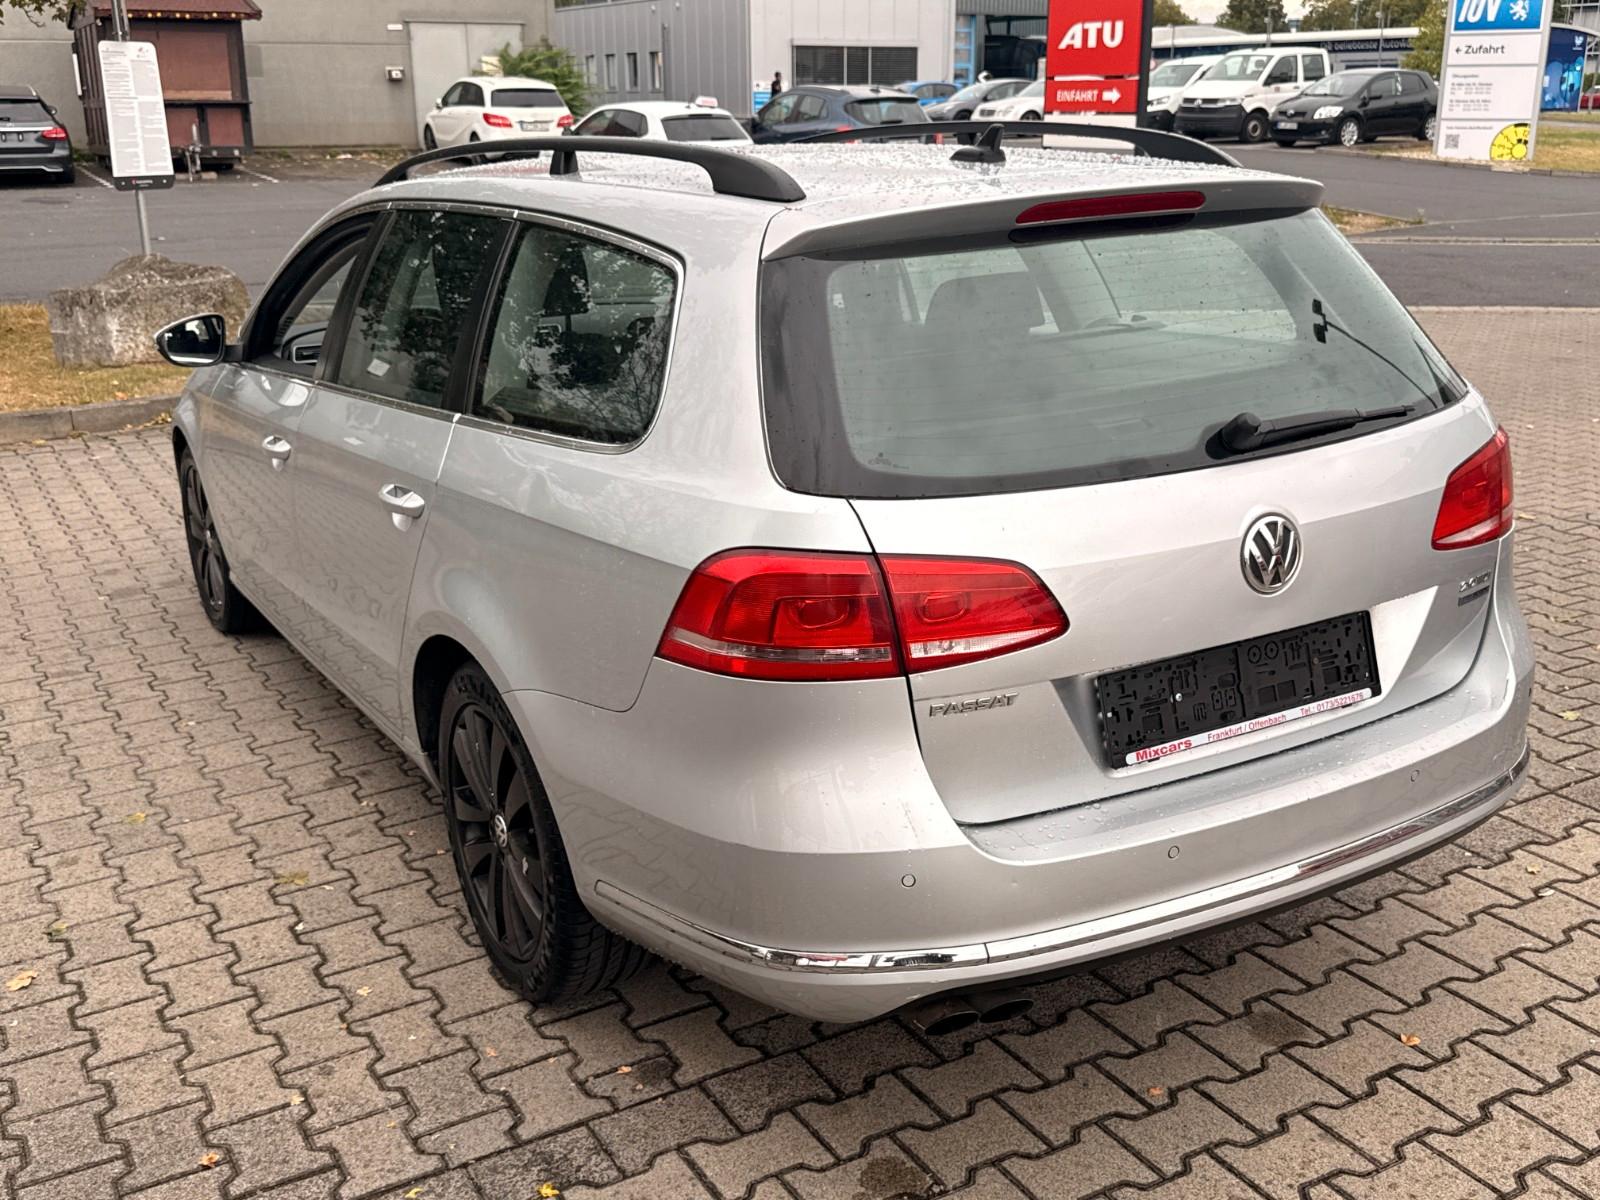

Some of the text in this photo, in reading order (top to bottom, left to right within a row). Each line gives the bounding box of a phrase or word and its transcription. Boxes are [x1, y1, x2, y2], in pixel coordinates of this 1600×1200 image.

[1057, 20, 1124, 49] ATU
[1464, 45, 1505, 54] Zufahrt
[1056, 89, 1098, 102] EINFAHRT
[929, 691, 1019, 717] PASSAT
[1135, 738, 1193, 762] Mixcars
[1207, 724, 1243, 742] Frankfurt
[1248, 713, 1287, 733] Offenbach
